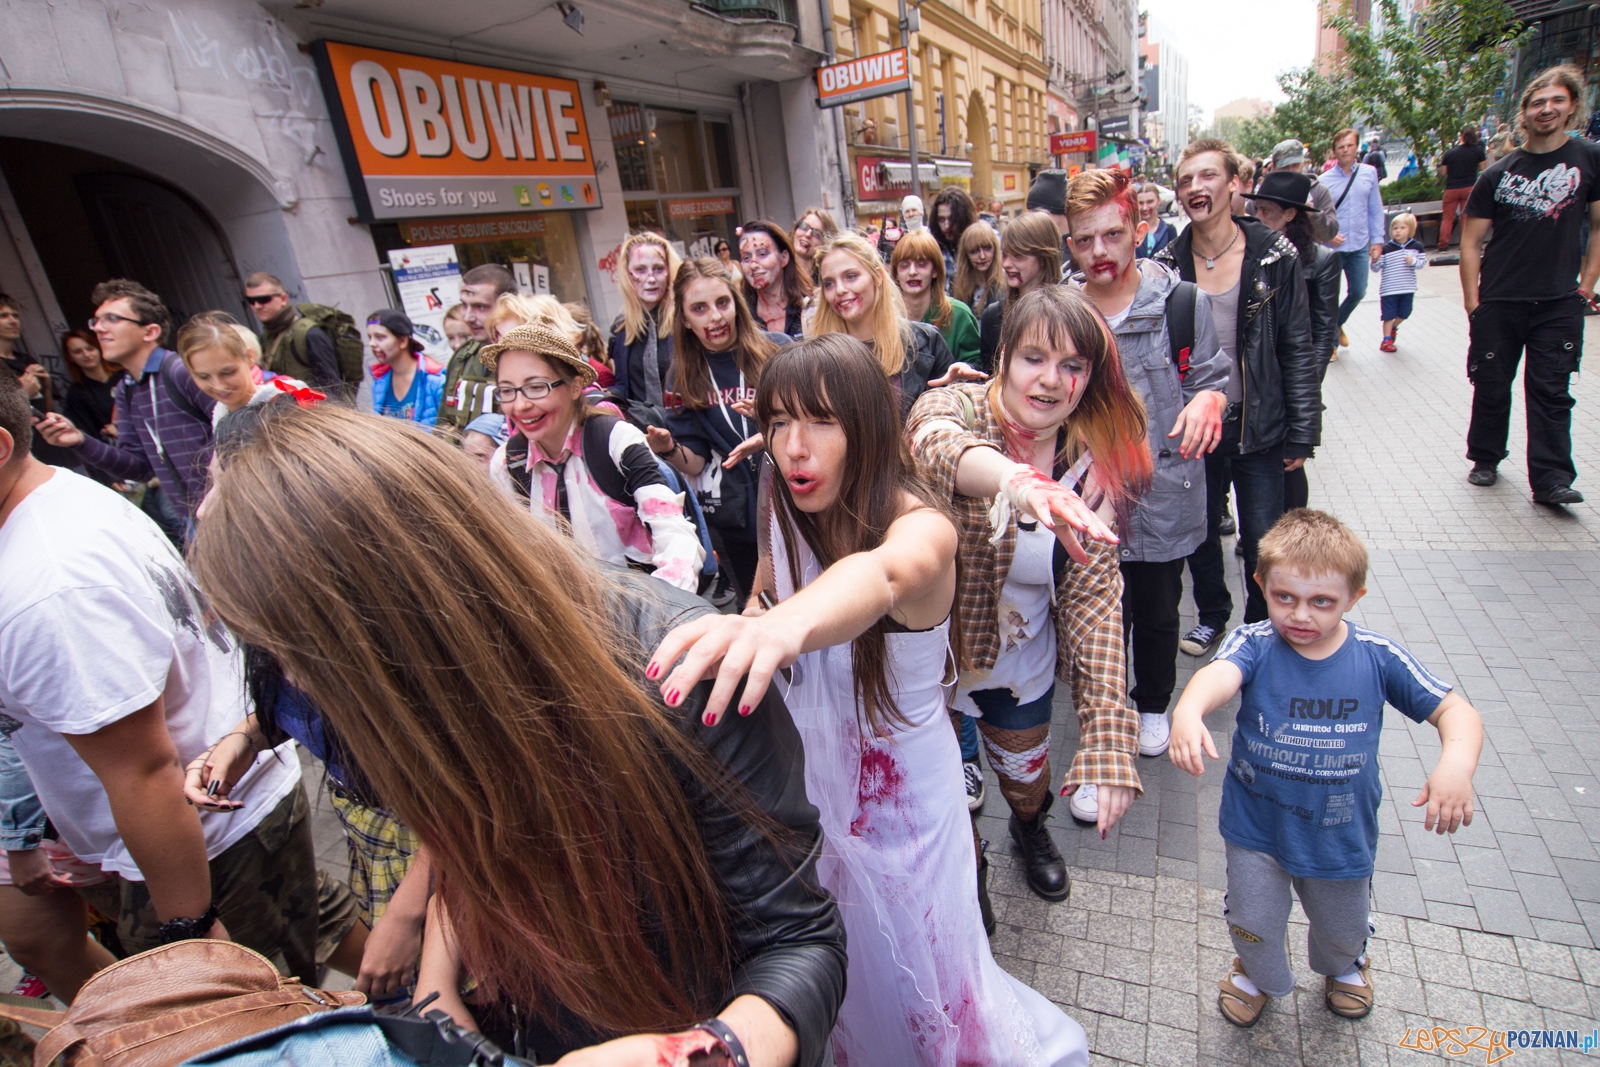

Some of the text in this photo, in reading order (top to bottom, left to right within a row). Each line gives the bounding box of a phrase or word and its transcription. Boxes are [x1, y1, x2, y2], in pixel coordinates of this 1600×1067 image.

[821, 52, 905, 92] OBUWIE
[350, 60, 586, 161] OBUWIE
[1059, 137, 1087, 147] VENUS
[378, 187, 498, 208] Shoes for you
[670, 202, 696, 215] OBUWIE
[697, 203, 702, 214] Z
[410, 217, 545, 242] POLSKIE OBUWIE SKÓRZANE
[1289, 697, 1359, 720] ROUP
[1275, 735, 1345, 748] WITHOUT LIMITED
[1247, 739, 1368, 769] WITHOUT LIMITED
[1271, 762, 1313, 776] FREEWORLD
